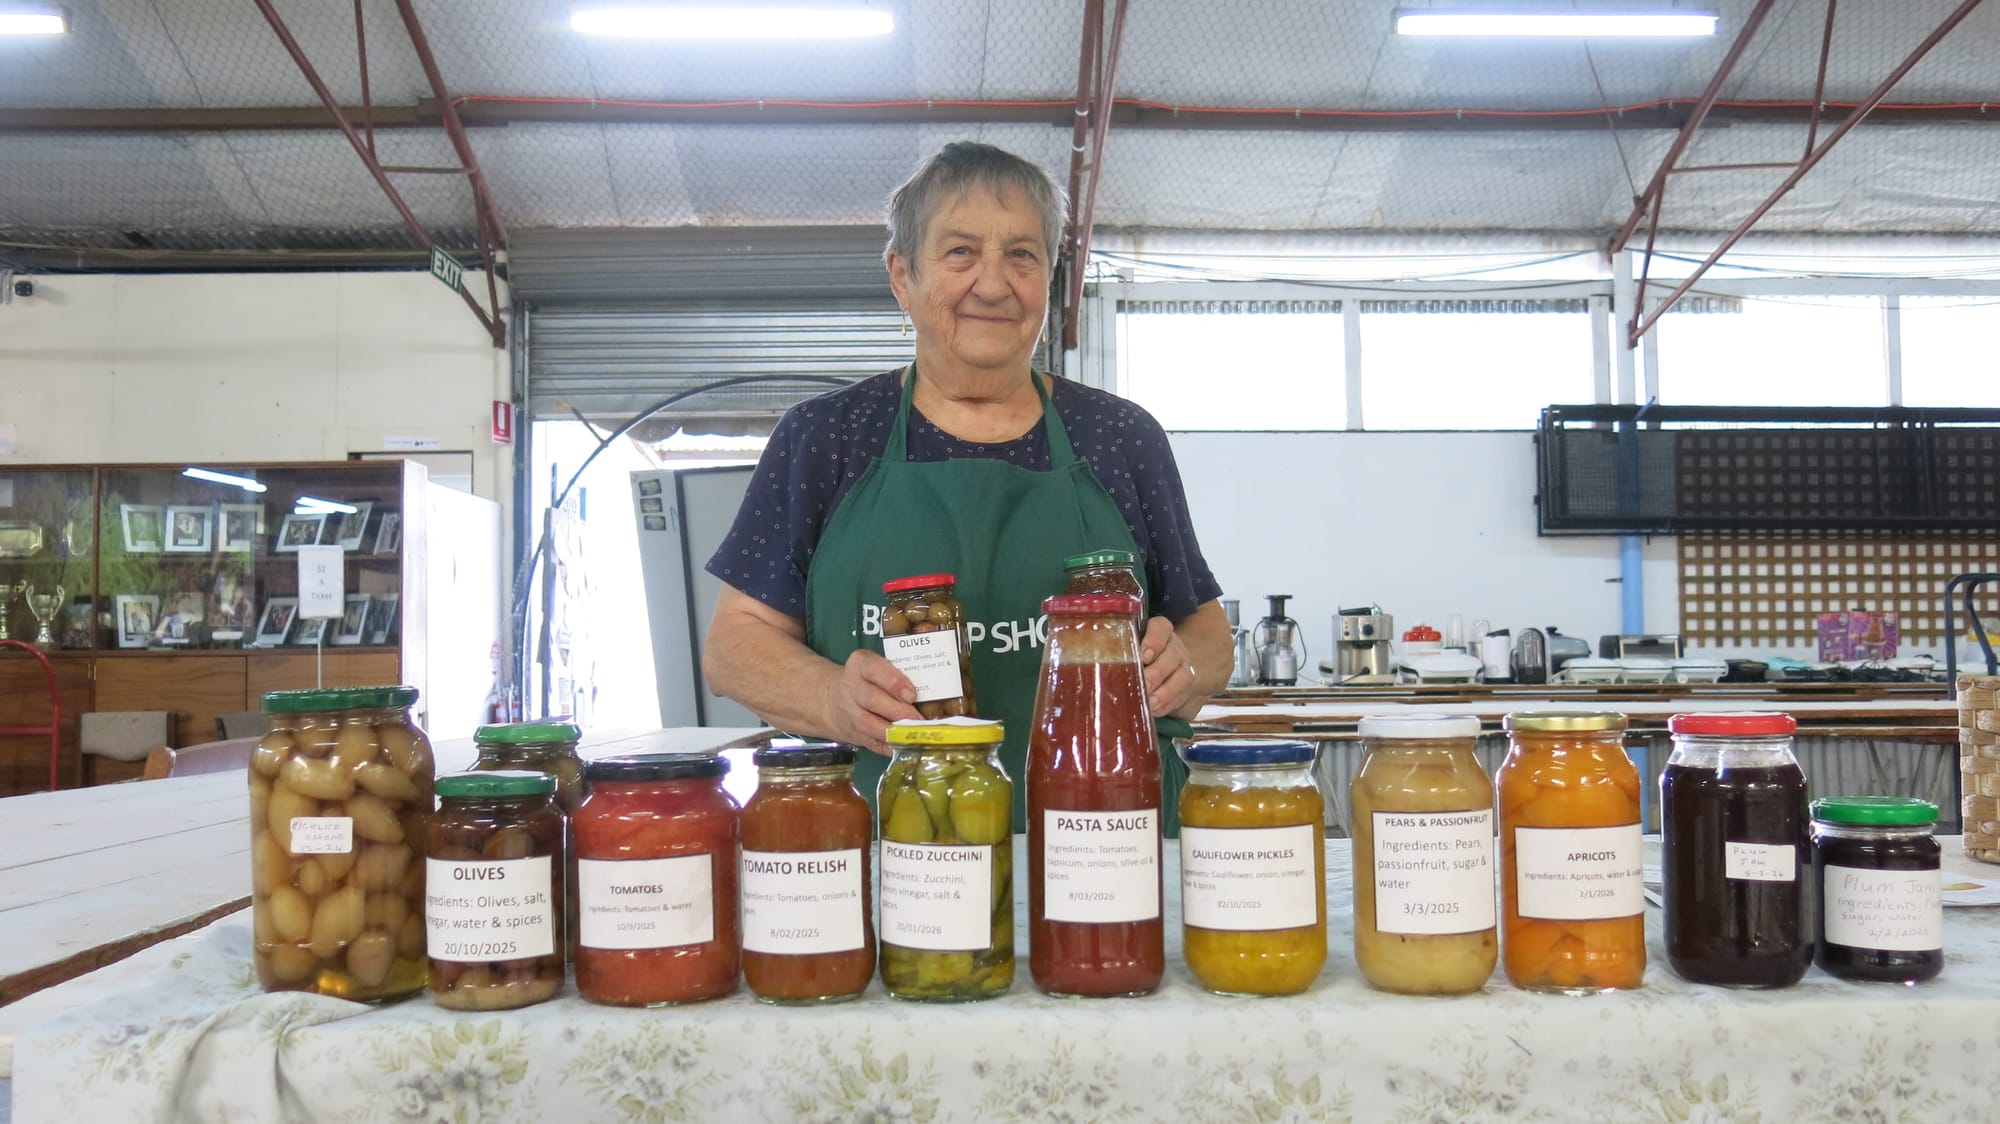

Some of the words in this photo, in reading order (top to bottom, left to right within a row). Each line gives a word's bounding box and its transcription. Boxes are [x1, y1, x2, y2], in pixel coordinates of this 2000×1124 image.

[434, 250, 461, 289] EXIT
[899, 637, 931, 648] OLIVES
[1057, 817, 1102, 831] PASTA
[1106, 816, 1149, 832] SAUCE
[1385, 818, 1416, 828] PEARS
[1419, 818, 1427, 827] &
[1430, 814, 1489, 827] PASSIONFRUIT
[1048, 844, 1097, 855] Ingredients:
[1382, 839, 1453, 853] Ingredients:
[1455, 839, 1483, 850] Pears,
[886, 846, 924, 860] PICKLED
[927, 851, 983, 862] ZUCCHINI
[1192, 849, 1255, 861] CAULIFLOWER
[1257, 849, 1295, 860] PICKLES
[1567, 851, 1617, 862] APRICOTS
[744, 859, 793, 875] TOMATO
[797, 859, 847, 875] RELISH
[1378, 858, 1450, 872] passionfruit,
[1453, 859, 1479, 871] sugar
[453, 866, 506, 881] OLIVES
[610, 884, 664, 895] TOMATOES
[1379, 879, 1411, 890] water
[477, 895, 521, 909] Olives,
[523, 892, 547, 905] salt,
[1403, 902, 1460, 916] 3/3/2025
[452, 918, 487, 929] water
[491, 916, 502, 929] &
[506, 914, 543, 929] spices
[769, 928, 821, 939] 8/02/2025
[444, 942, 518, 957] 20/10/2025
